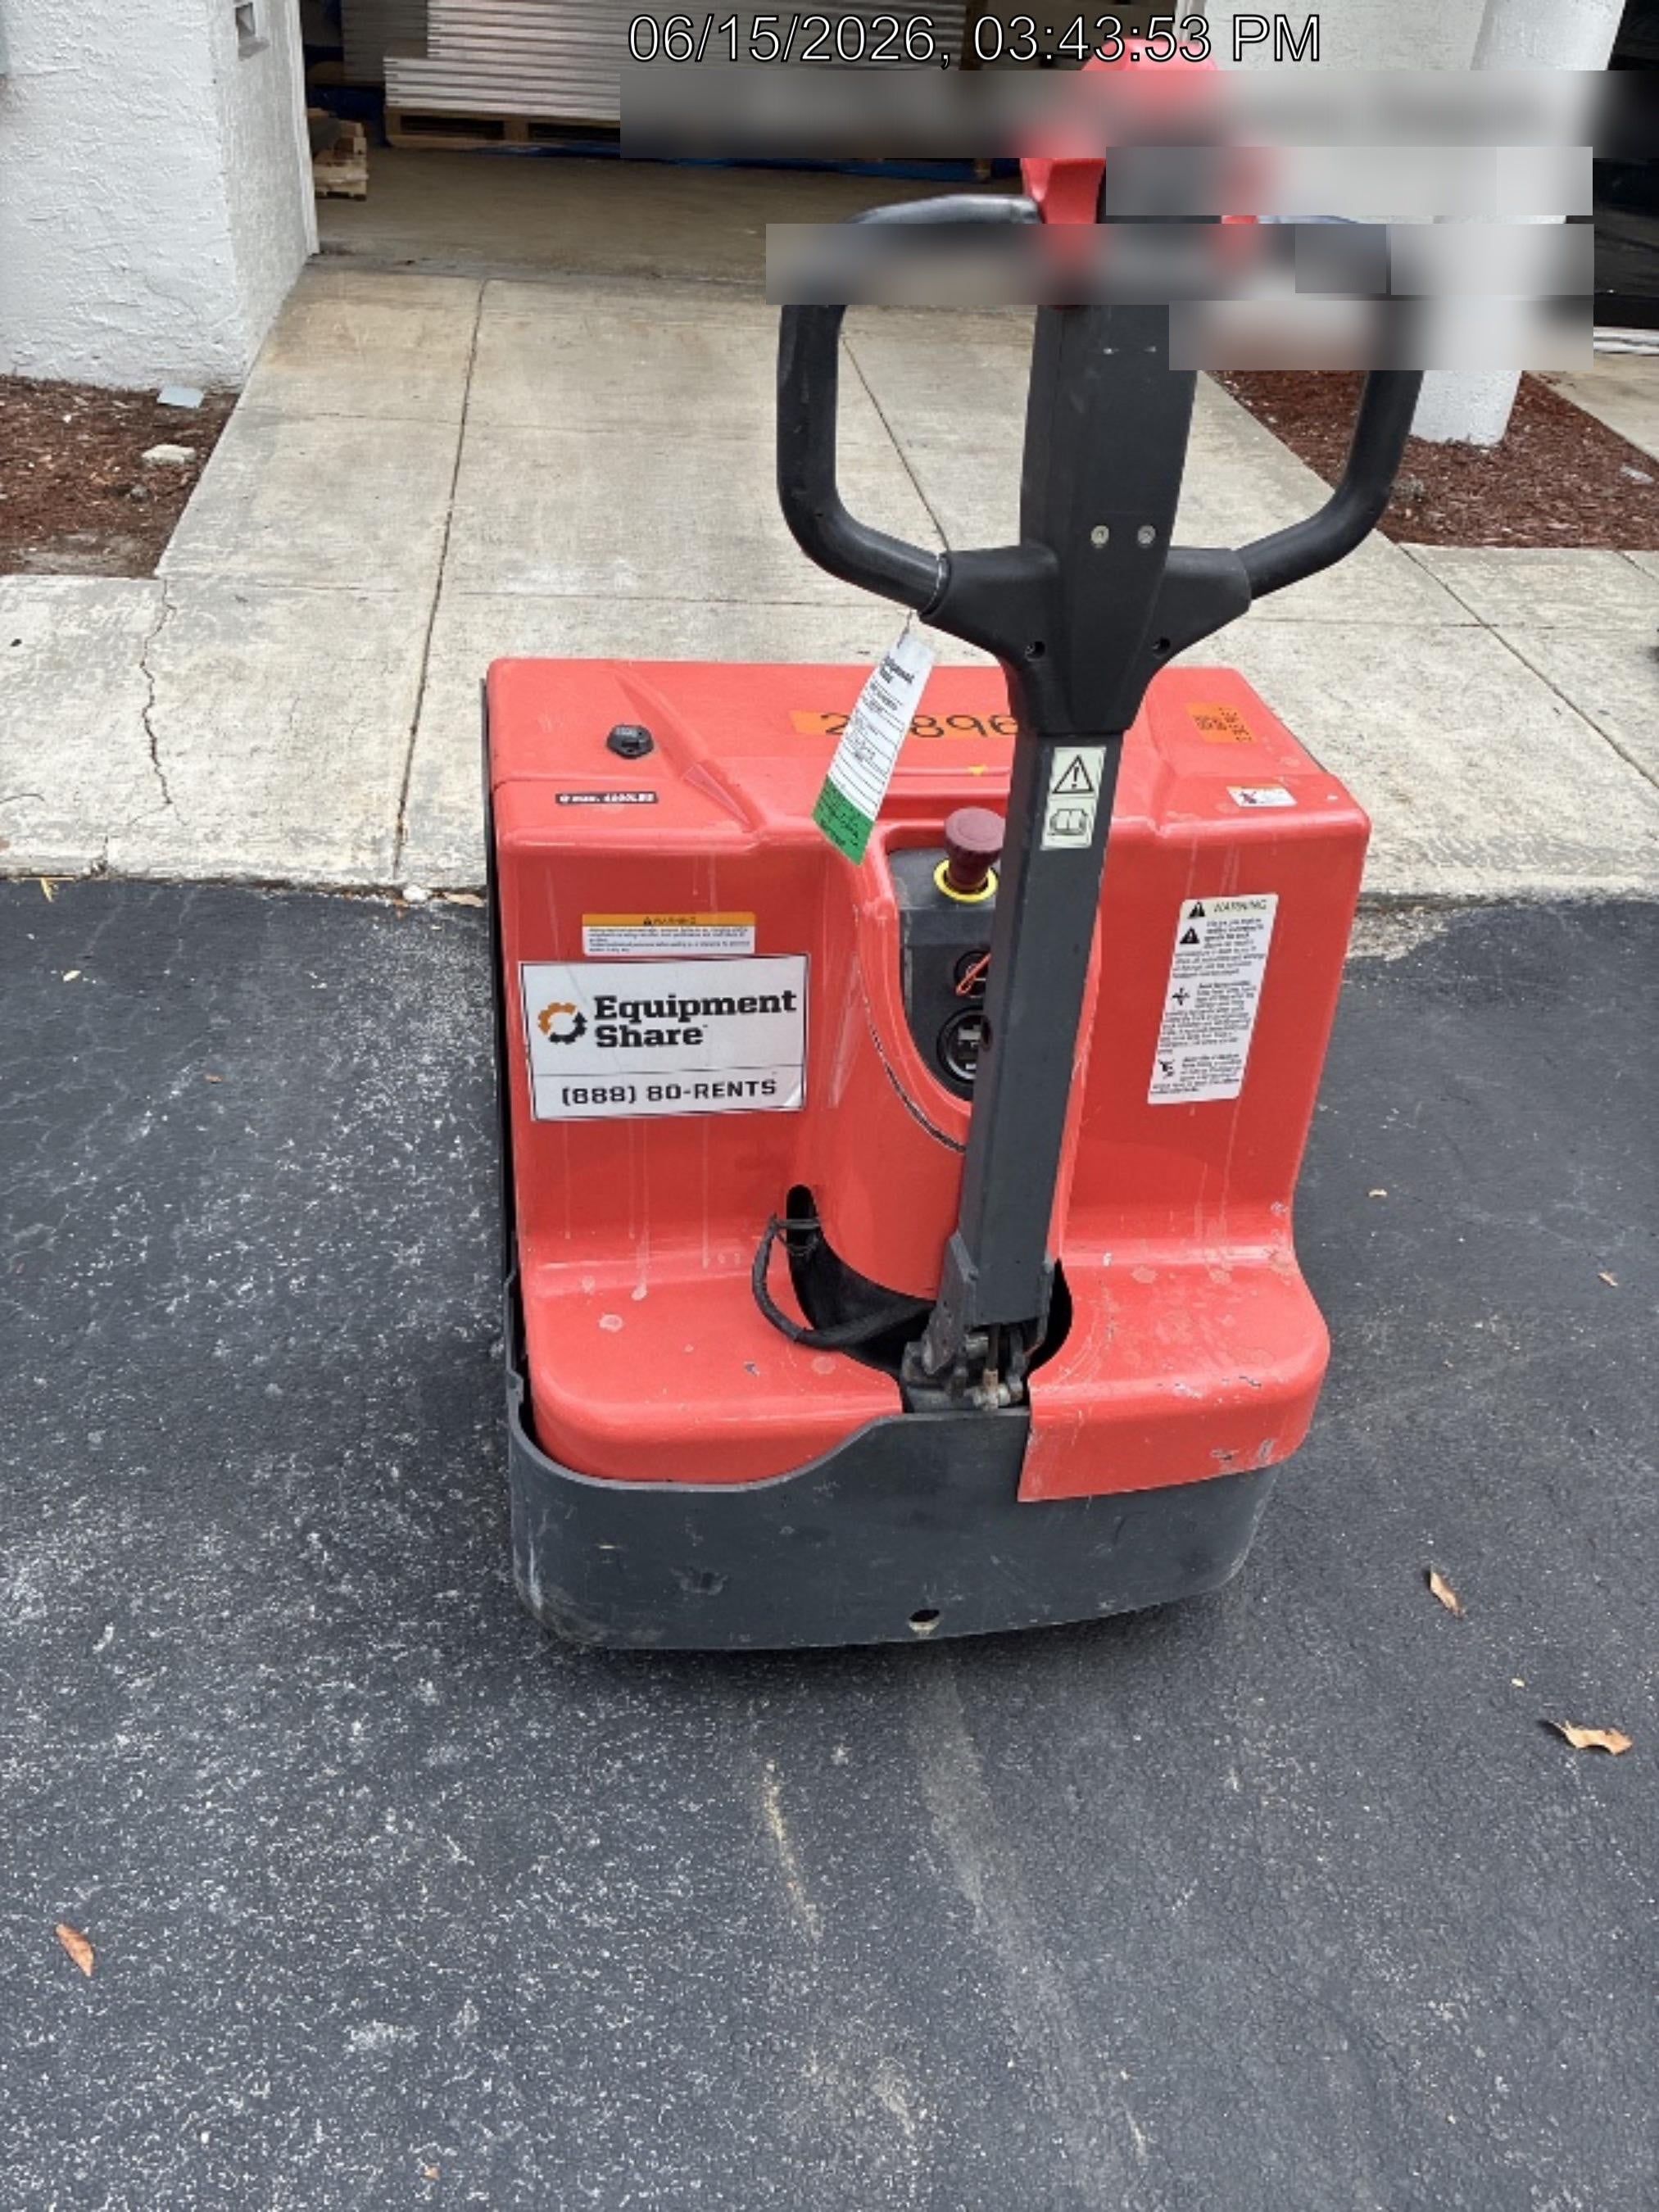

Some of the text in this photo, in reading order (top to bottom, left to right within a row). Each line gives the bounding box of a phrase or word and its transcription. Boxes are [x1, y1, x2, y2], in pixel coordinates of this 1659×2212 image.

[820, 712, 1018, 737] 2896
[594, 990, 797, 1022] Equipment
[595, 1024, 704, 1048] Share
[562, 1079, 777, 1106] (888) 80-RENTS
